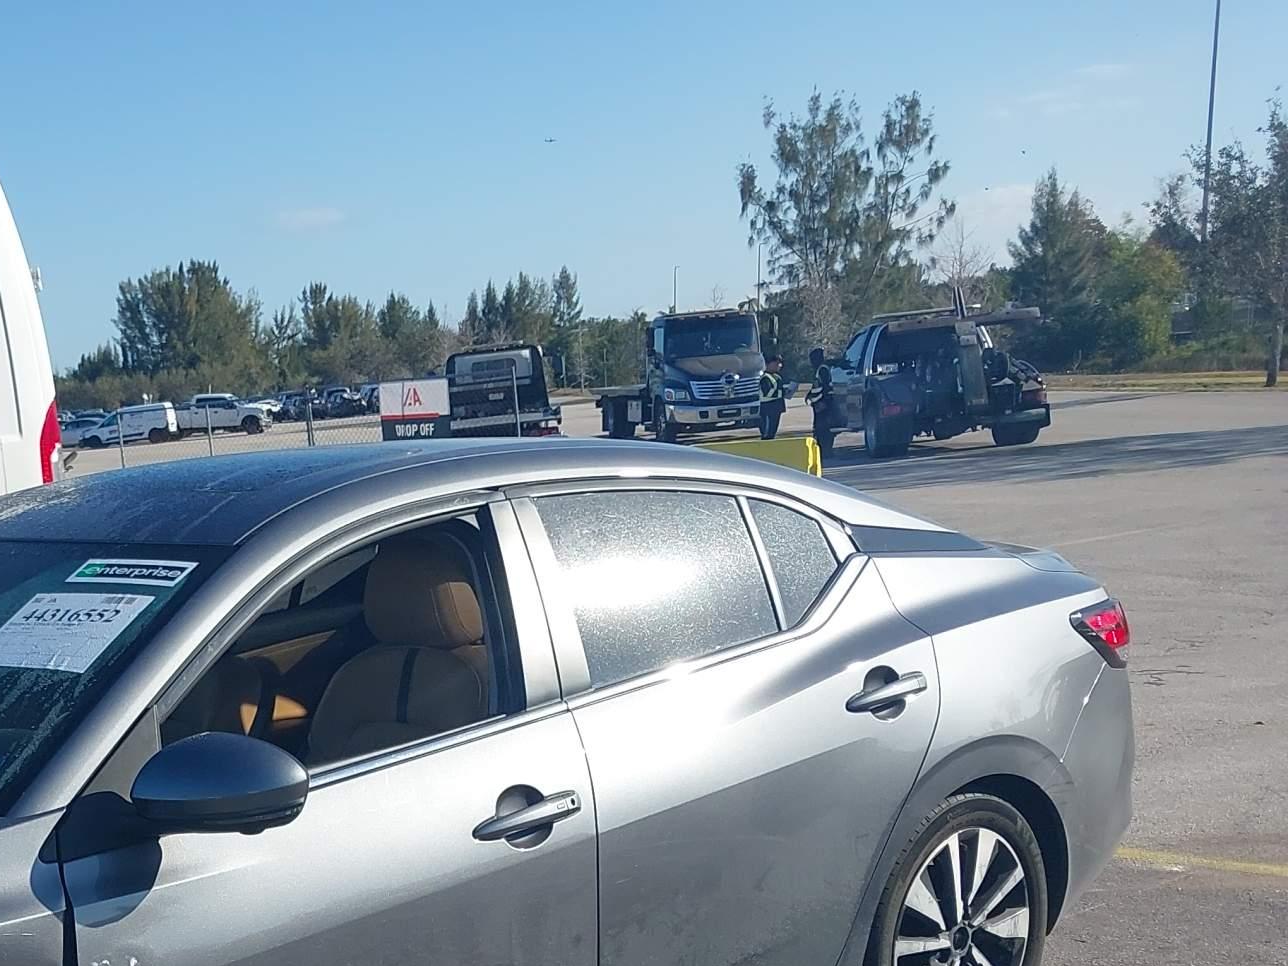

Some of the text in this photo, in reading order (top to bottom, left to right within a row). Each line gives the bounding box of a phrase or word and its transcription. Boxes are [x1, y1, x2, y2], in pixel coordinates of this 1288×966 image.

[420, 422, 434, 436] OFF
[83, 565, 182, 578] enterprise
[22, 608, 122, 623] 44316552
